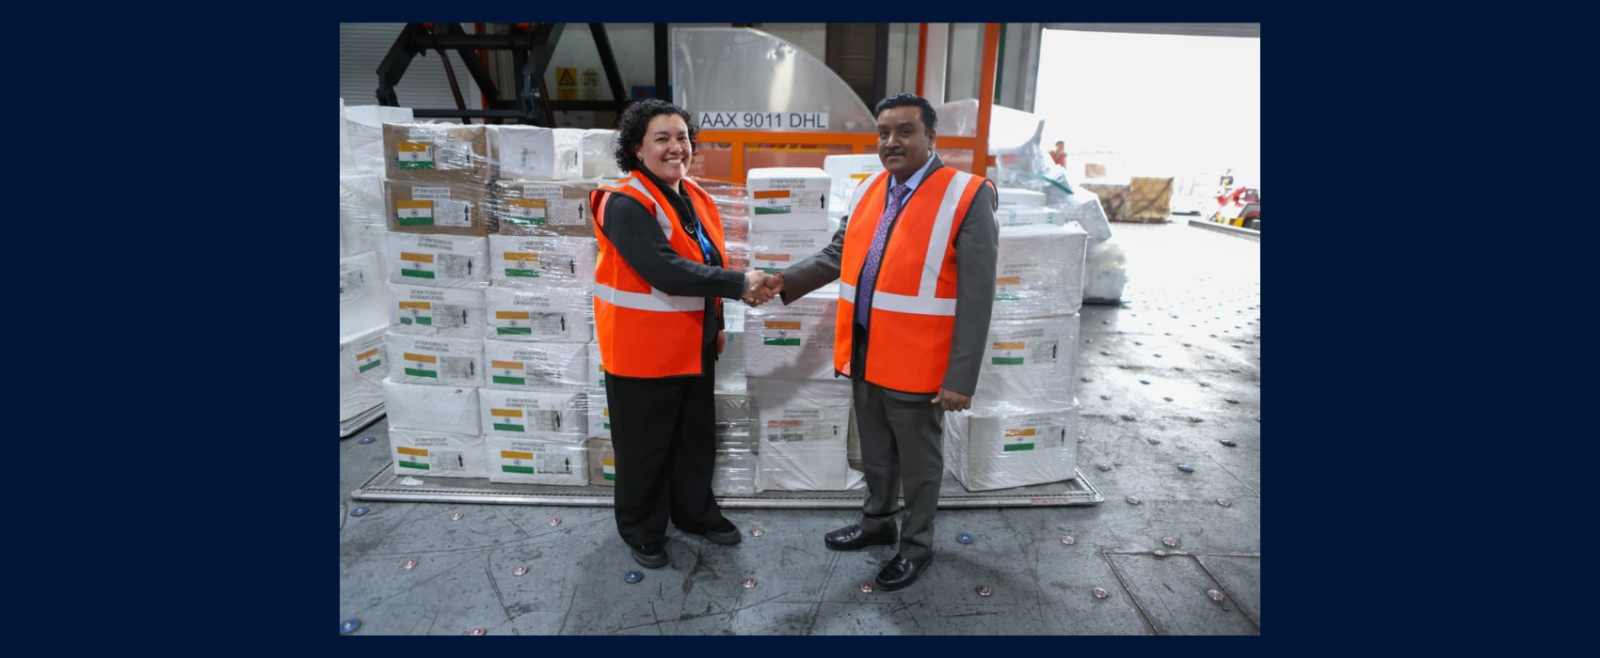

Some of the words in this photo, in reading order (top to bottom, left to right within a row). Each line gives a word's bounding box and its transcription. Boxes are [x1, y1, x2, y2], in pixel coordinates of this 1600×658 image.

[701, 112, 738, 128] AAX
[743, 112, 782, 128] 9011
[789, 113, 826, 129] DHL
